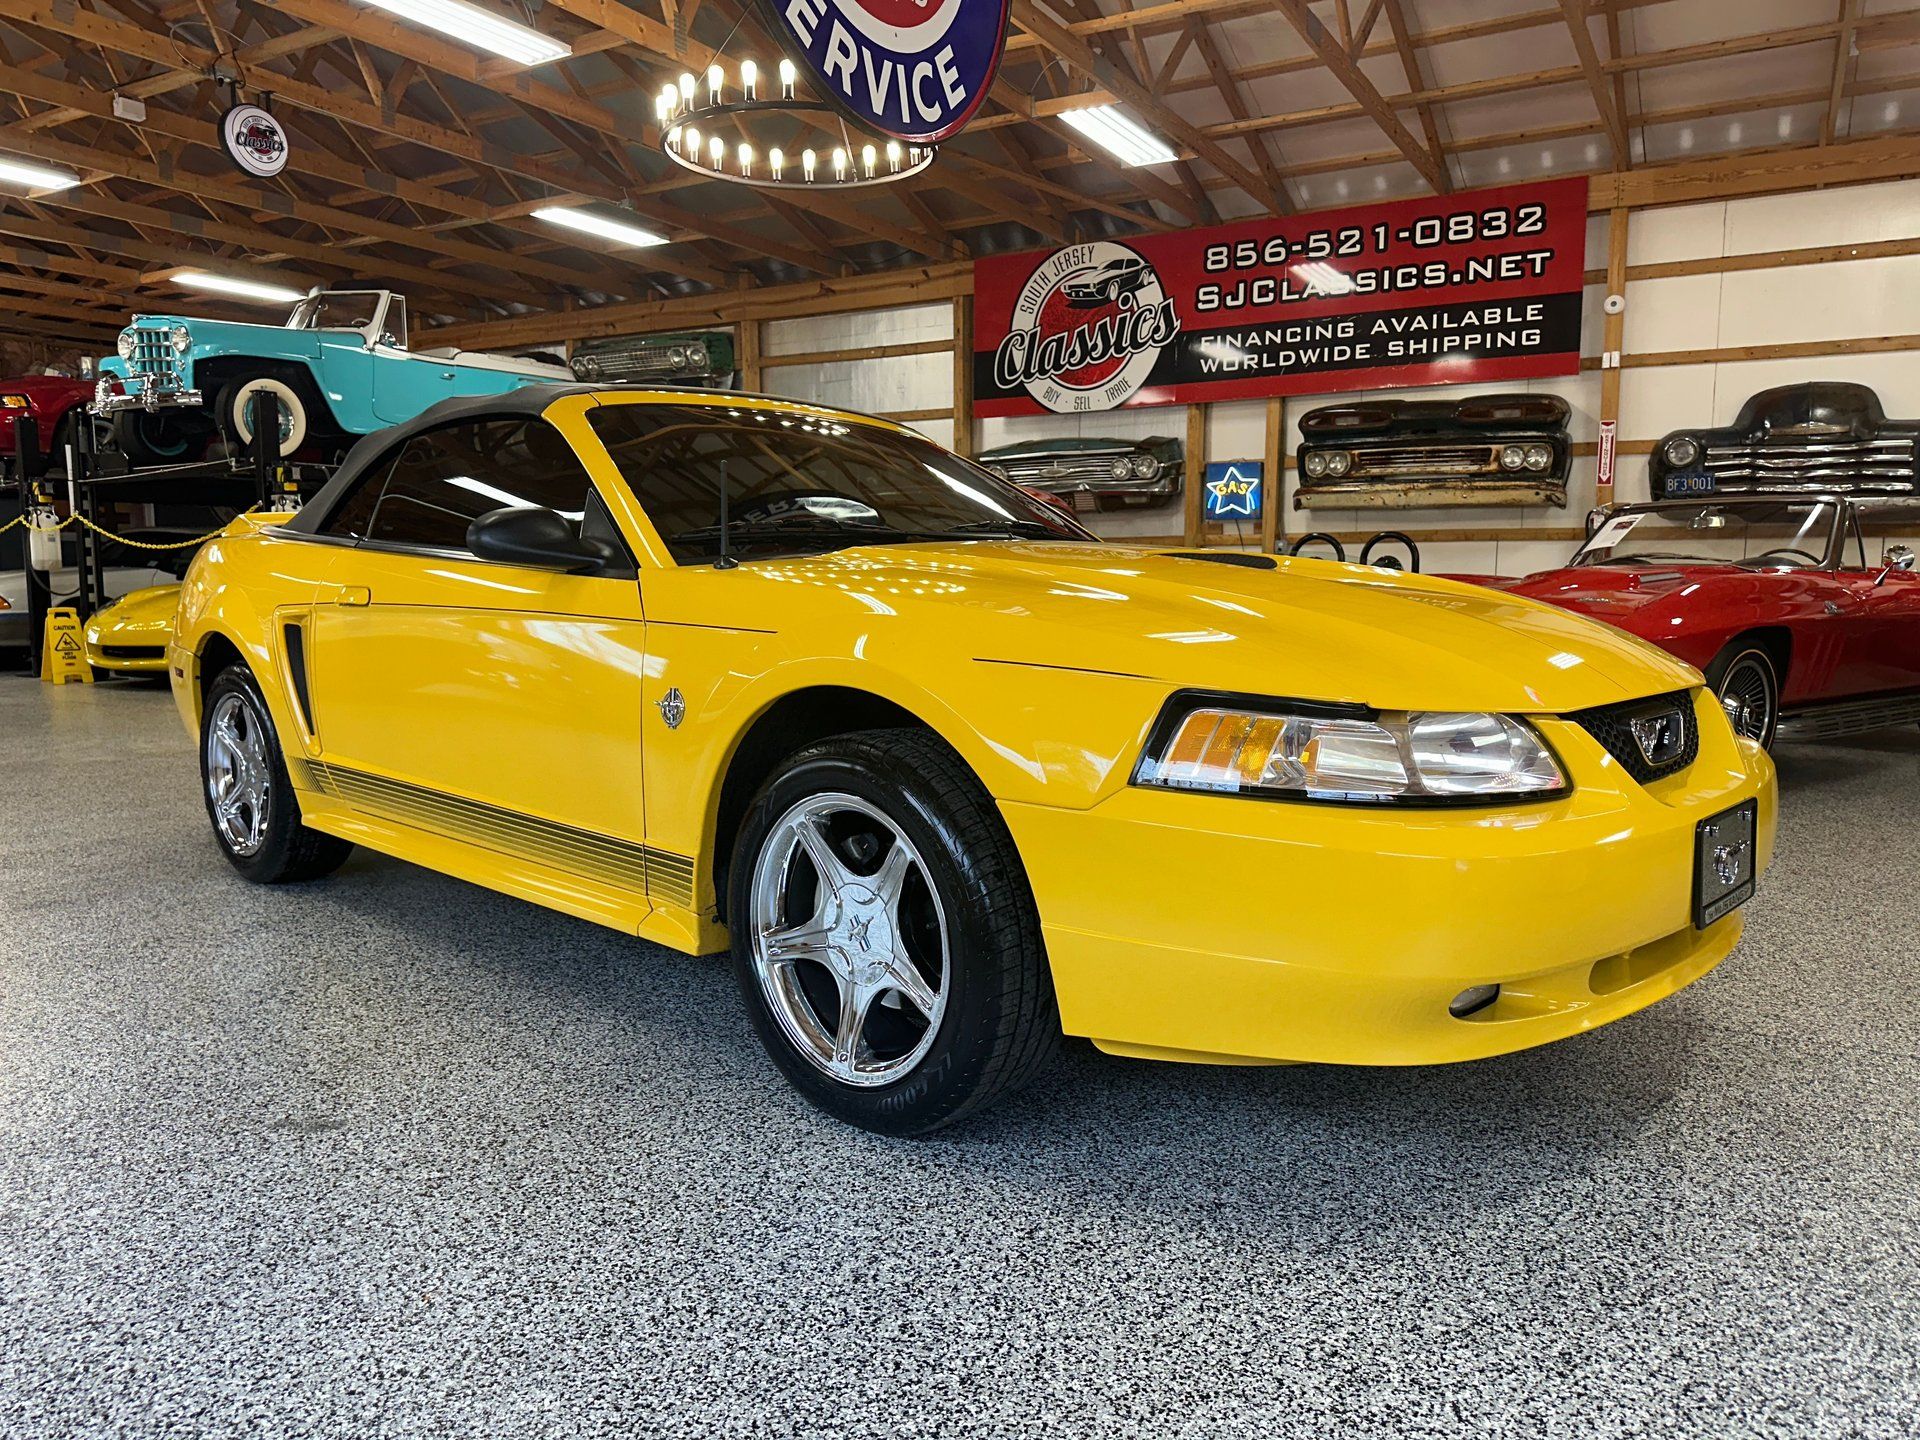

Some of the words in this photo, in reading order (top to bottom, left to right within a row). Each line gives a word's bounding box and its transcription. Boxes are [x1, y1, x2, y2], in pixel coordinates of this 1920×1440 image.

[785, 0, 966, 123] ERVICE
[236, 132, 285, 152] Classics
[1206, 206, 1543, 270] 856-521-0832
[1020, 271, 1052, 314] SOUTH
[1052, 245, 1095, 277] JERSEY
[1197, 252, 1551, 310] SJCLASSICS.NET
[995, 292, 1181, 388] Classics
[1200, 344, 1371, 373] WORLDWIDE
[1387, 329, 1541, 357] SHIPPING
[1201, 322, 1355, 350] FINANCING
[1370, 304, 1543, 335] AVAILABLE
[1043, 386, 1062, 405] BUY
[1073, 396, 1092, 411] SELL
[1105, 376, 1132, 403] TRADE
[1216, 481, 1248, 495] GAS
